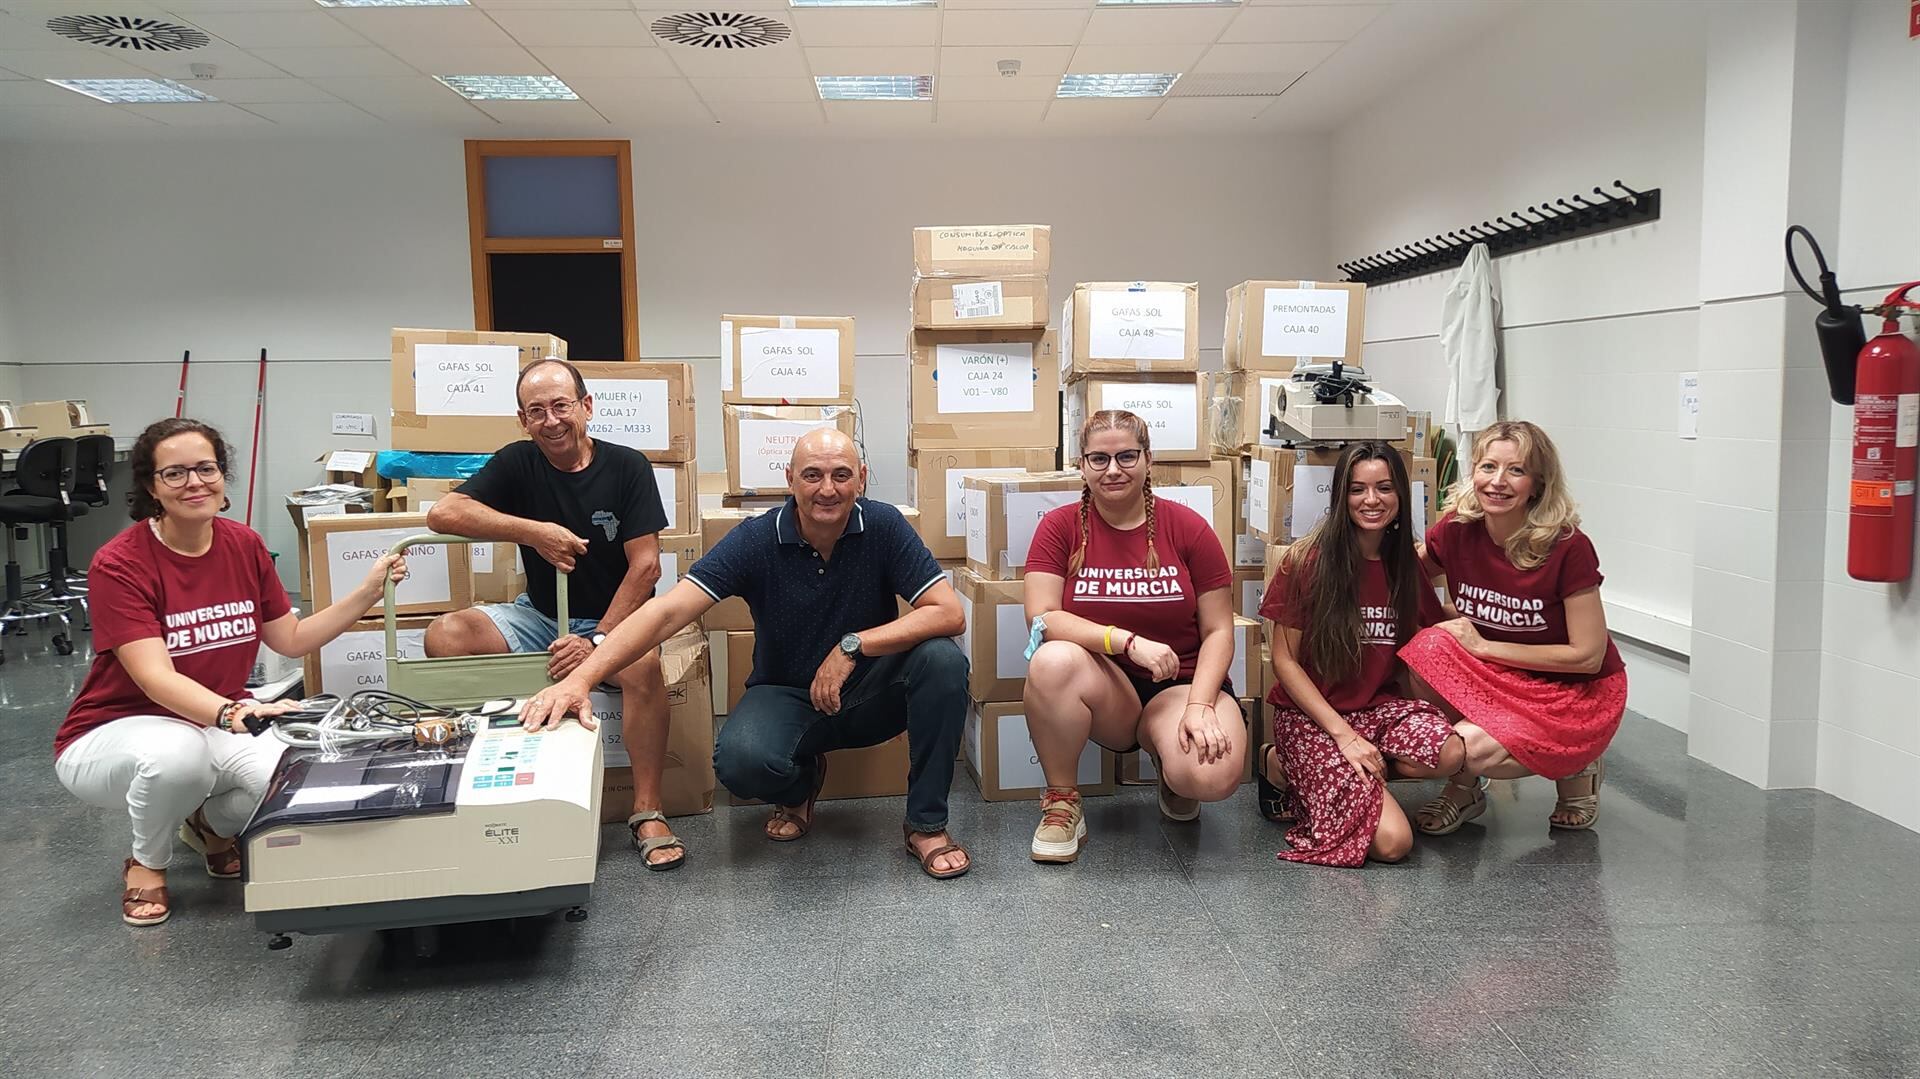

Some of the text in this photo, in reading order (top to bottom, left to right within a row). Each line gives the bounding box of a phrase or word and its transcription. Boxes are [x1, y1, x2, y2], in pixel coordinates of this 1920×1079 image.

[1111, 308, 1162, 317] GAFAS SOL
[1273, 304, 1336, 314] PREMONTADAS
[1119, 328, 1154, 337] CAJA 48
[1283, 325, 1320, 334] CAJA 40
[762, 346, 815, 356] GAFAS SOL
[961, 354, 1009, 366] VARÓN (+)
[438, 362, 494, 372] GAFAS SOL
[770, 367, 807, 376] CAJA 45
[967, 371, 1003, 381] CAJA 24
[447, 384, 485, 393] CAJA 41
[962, 388, 980, 397] V01
[990, 387, 1009, 396] V80
[594, 392, 642, 402] MUJER (+)
[1123, 400, 1173, 409] GAFAS SOL
[600, 408, 637, 417] CAJA 17
[586, 424, 613, 433] M262
[624, 424, 651, 433] M333
[1155, 420, 1166, 429] 44
[765, 435, 799, 445] NEUTR
[342, 550, 379, 561] GAFAS
[1078, 565, 1179, 580] UNIVERSIDAD
[1074, 579, 1183, 596] DE MURCIA
[1458, 582, 1544, 611] UNIVERSIDAD
[166, 600, 255, 628] UNIVERSIDAD
[1455, 596, 1547, 626] DE MURCIA
[167, 617, 257, 650] DE MURCIA
[346, 649, 408, 662] GAFAS OL
[357, 674, 384, 685] CAJA
[592, 711, 623, 721] NDAS
[607, 734, 621, 744] 52
[485, 827, 520, 838] ÉLITE
[497, 836, 519, 845] XXI
